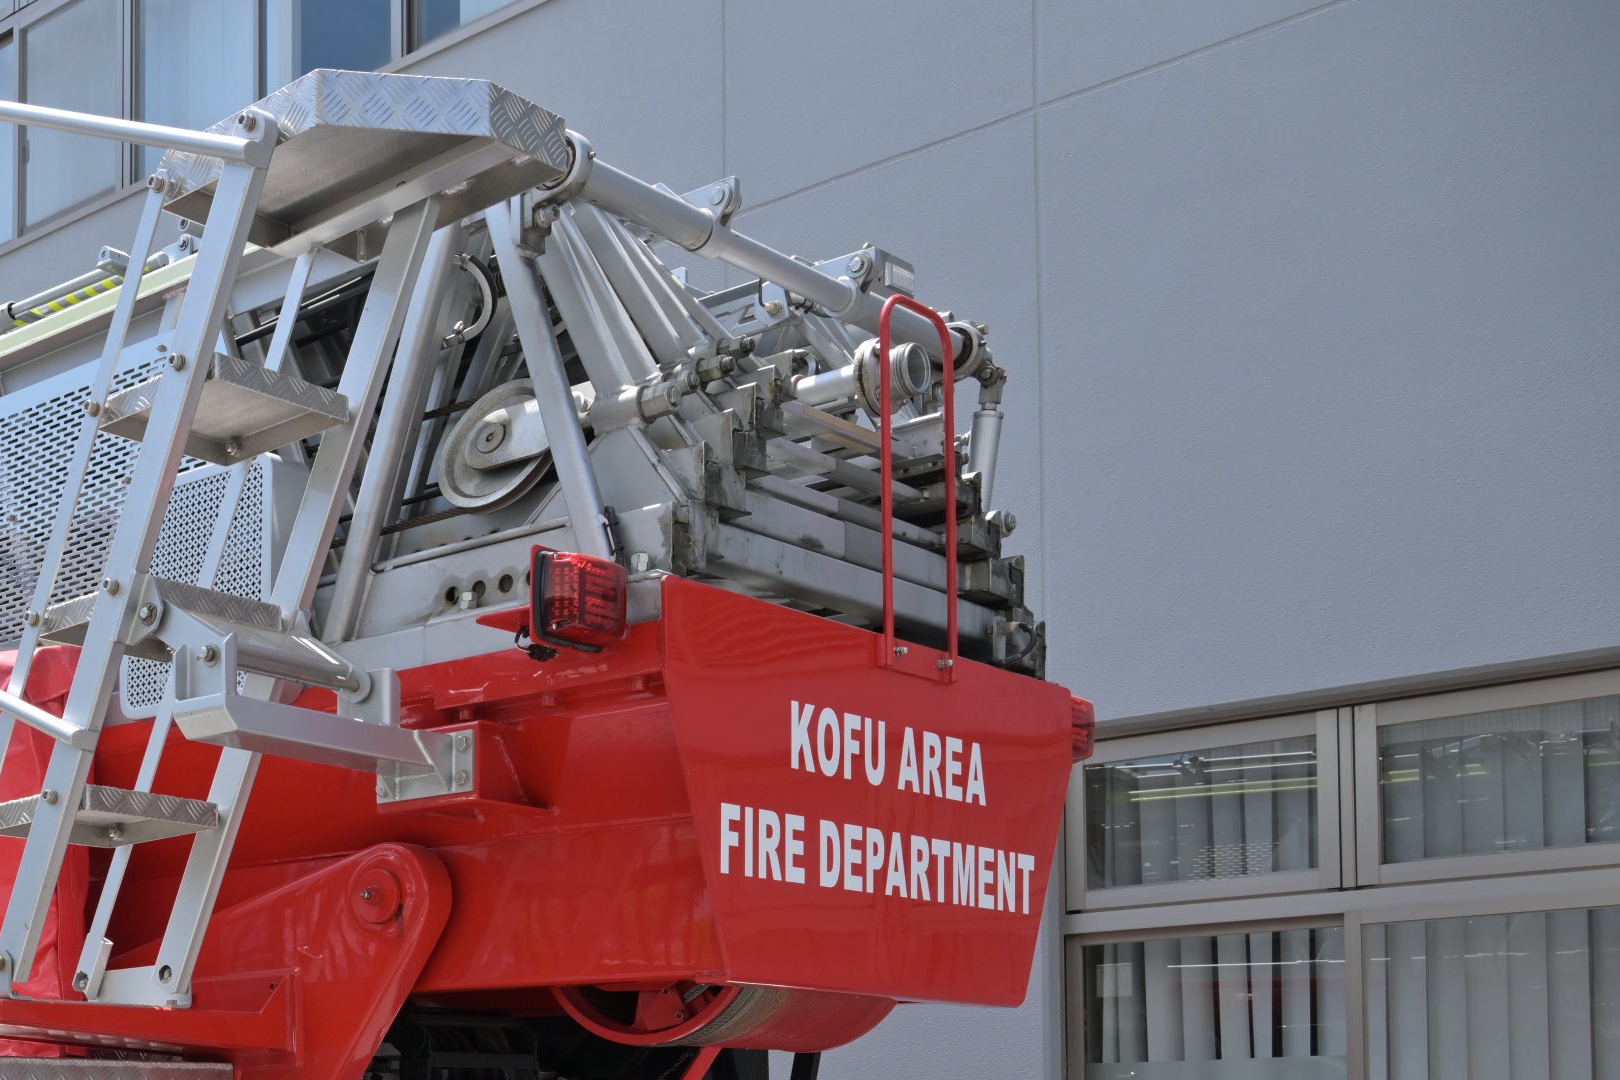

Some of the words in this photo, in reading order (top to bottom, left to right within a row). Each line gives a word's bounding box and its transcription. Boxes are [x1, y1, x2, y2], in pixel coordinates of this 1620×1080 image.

[790, 700, 886, 786] KOFU
[897, 726, 987, 806] AREA
[720, 802, 806, 885] FIRE
[819, 819, 1036, 915] DEPARTMENT
